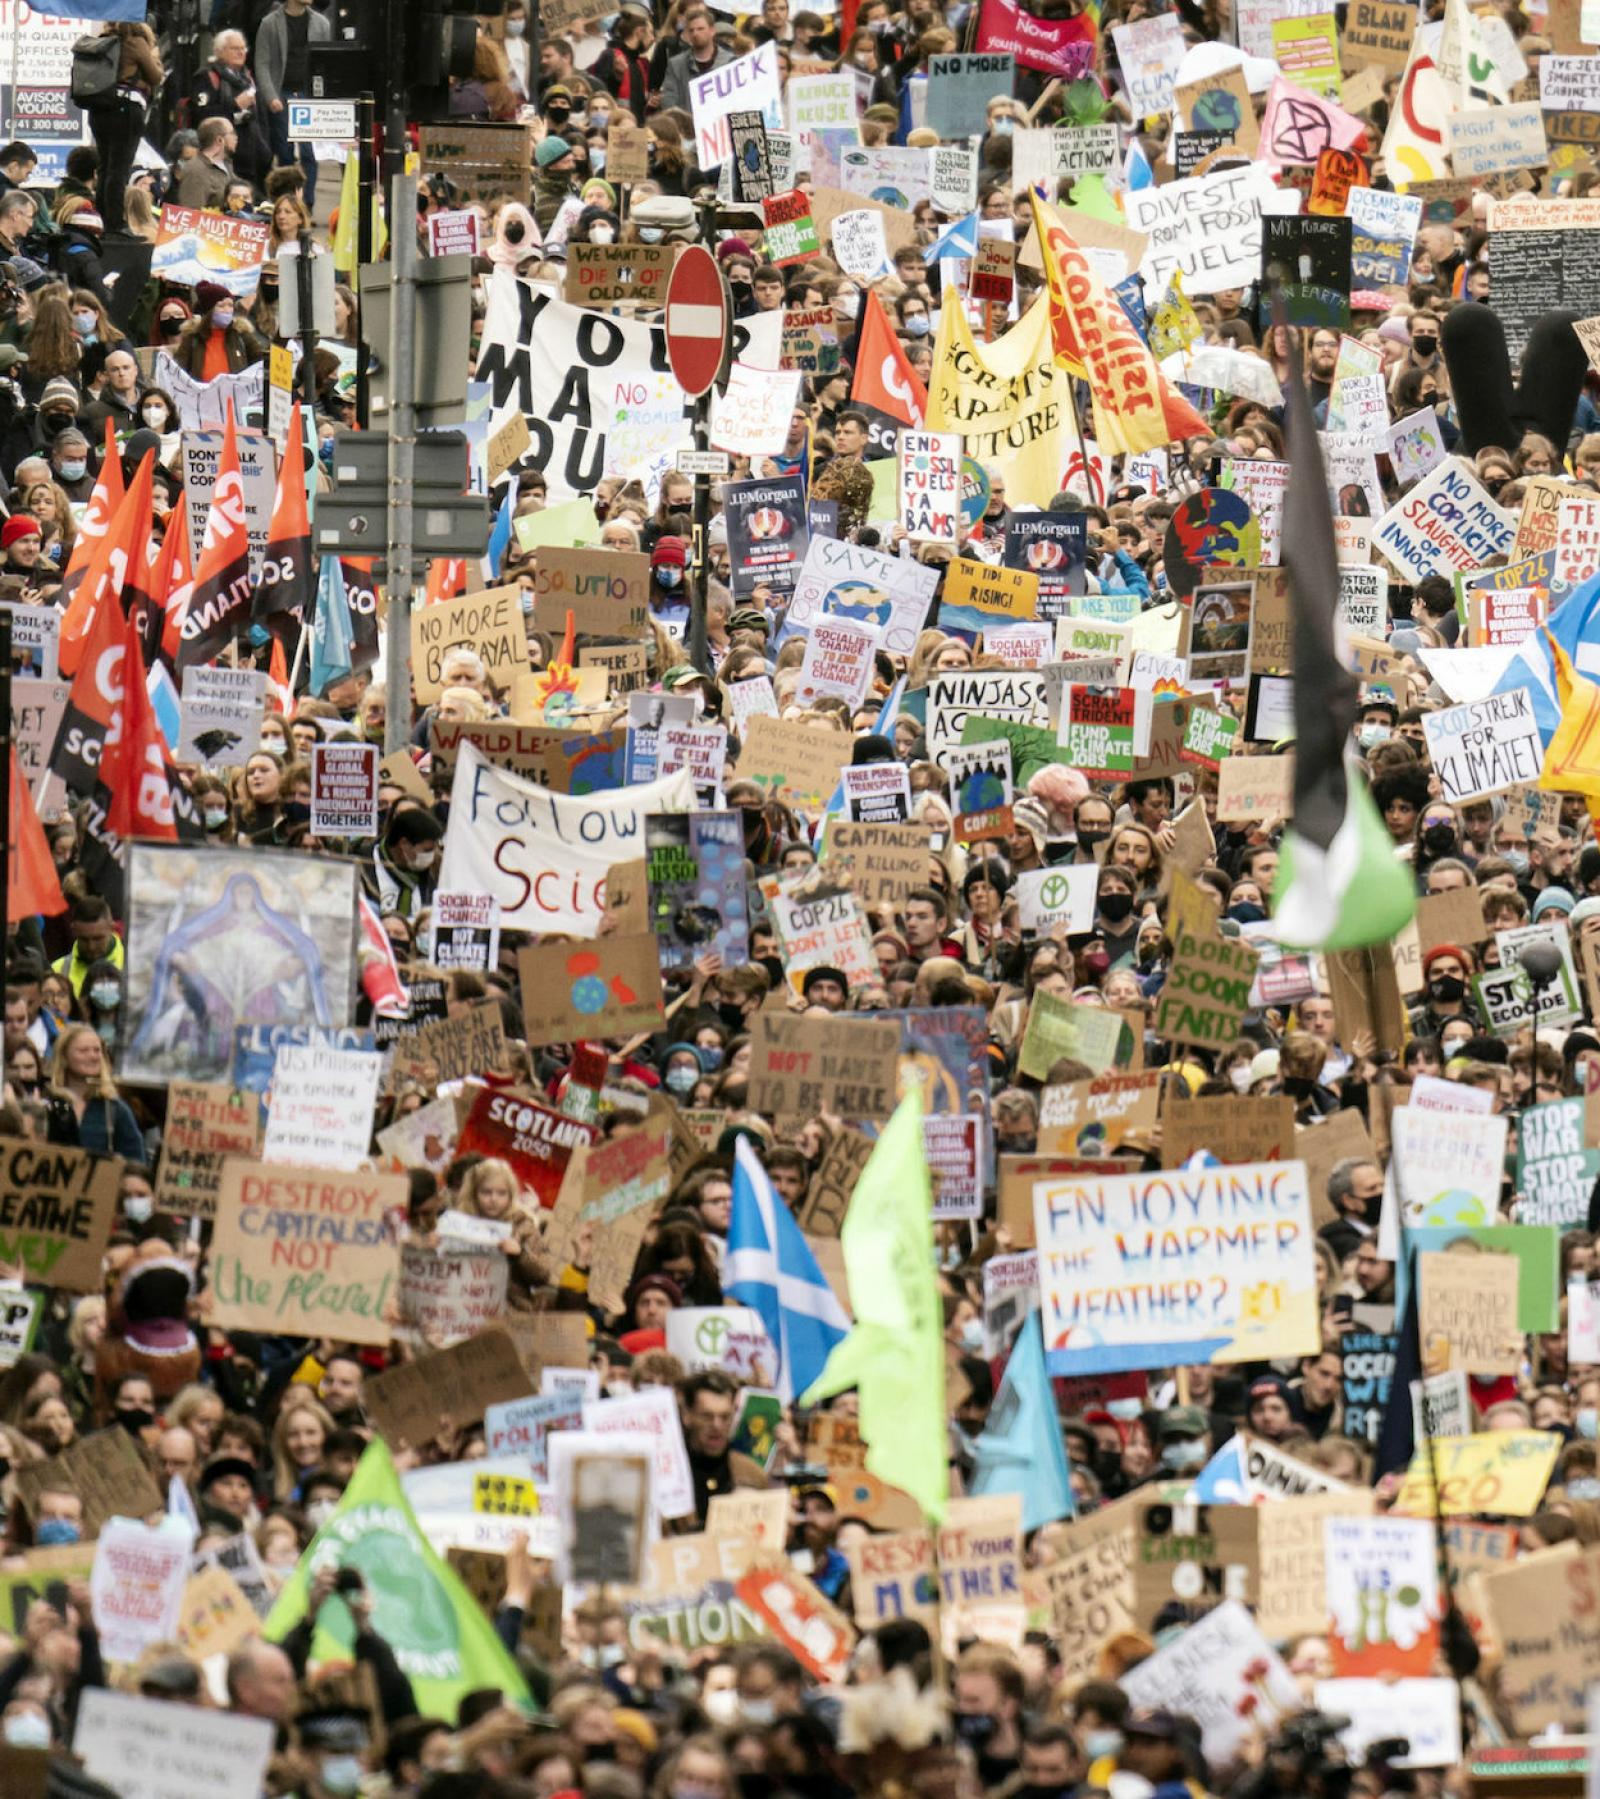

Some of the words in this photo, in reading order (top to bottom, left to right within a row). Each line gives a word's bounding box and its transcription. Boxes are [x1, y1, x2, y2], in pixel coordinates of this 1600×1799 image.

[934, 58, 962, 74] NO
[966, 55, 1011, 72] MORE
[698, 55, 768, 105] FUCK
[16, 91, 66, 103] AVISON
[17, 103, 66, 115] YOUNG
[1138, 175, 1249, 224] DIVEST
[166, 208, 191, 225] WE
[200, 215, 235, 234] MUST
[238, 220, 267, 242] RISE
[768, 224, 794, 242] FUND
[577, 249, 600, 263] WE
[604, 249, 640, 263] WANT
[644, 250, 660, 262] TO
[1152, 238, 1261, 284] FUELS
[580, 268, 606, 284] DIE
[640, 268, 663, 284] OF
[589, 287, 616, 299] OLD
[620, 287, 656, 299] AGE
[905, 437, 941, 452] END
[905, 471, 955, 492] FUELS
[1441, 470, 1470, 498] NO
[1464, 495, 1514, 547] MORE
[906, 510, 953, 537] BAMS
[1420, 540, 1441, 558] OF
[1495, 563, 1550, 589] COP26
[969, 588, 1014, 608] RISING!
[420, 617, 441, 642] NO
[448, 600, 508, 634] MORE
[194, 670, 252, 687] WINTER
[936, 680, 1031, 709] NINJAS
[1074, 694, 1117, 710] SCRAP
[1073, 709, 1131, 724] TRIDENT
[666, 731, 721, 747] SOCIALIST
[1071, 725, 1108, 739] FUND
[1460, 725, 1496, 748] FOR
[324, 749, 364, 762] COMBAT
[1072, 740, 1133, 756] CLIMATE
[325, 762, 362, 774] GLOBAL
[1072, 752, 1106, 769] JOBS
[320, 774, 370, 786] WARMING
[850, 779, 902, 792] TRANSPORT
[333, 786, 367, 798] RISING
[315, 813, 372, 827] TOGETHER
[963, 816, 1000, 831] COP26
[790, 903, 850, 929] COP26
[1179, 936, 1260, 971] BORIS
[1492, 994, 1565, 1024] ECOCIDE
[1159, 1001, 1240, 1043] FARTS
[1523, 1103, 1581, 1131] STOP
[1523, 1127, 1581, 1155] WAR
[8, 1147, 99, 1190] CAN'T
[1523, 1154, 1586, 1186] STOP
[240, 1174, 379, 1214] DESTROY
[1047, 1171, 1299, 1232] ENJOYING
[271, 1240, 338, 1272] NOT
[1046, 1248, 1095, 1276] THE
[1116, 1219, 1299, 1269] WARMER
[969, 1536, 1014, 1558] YOUR
